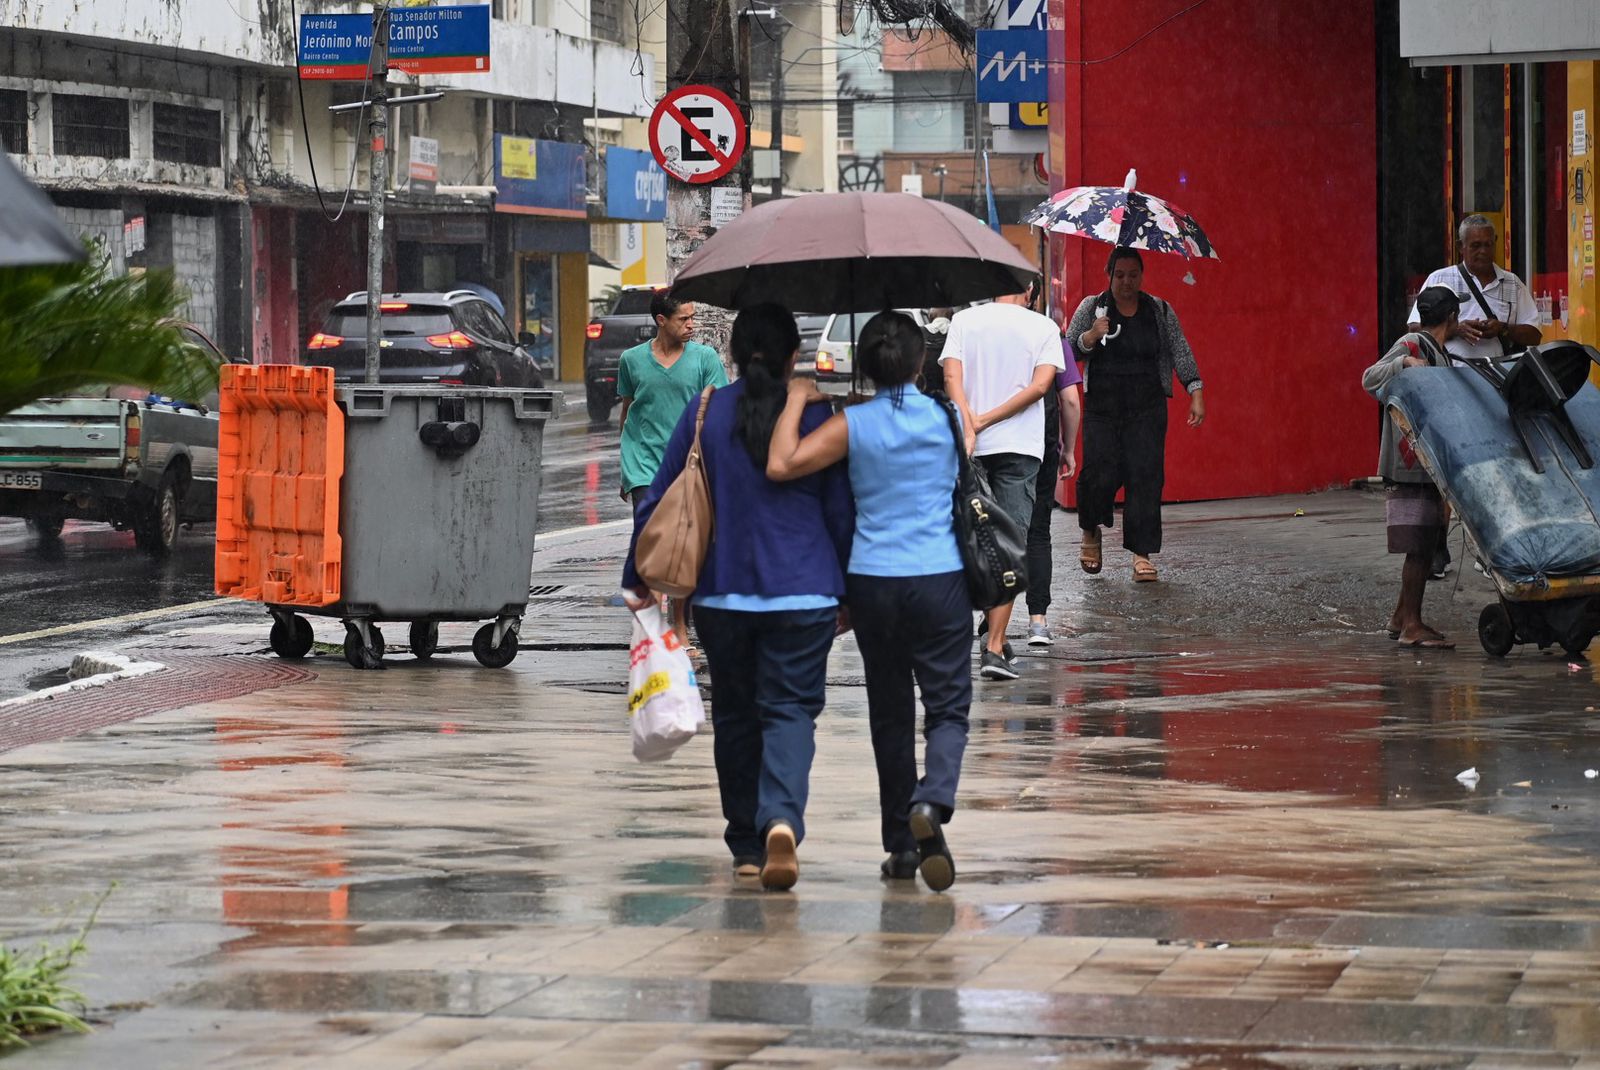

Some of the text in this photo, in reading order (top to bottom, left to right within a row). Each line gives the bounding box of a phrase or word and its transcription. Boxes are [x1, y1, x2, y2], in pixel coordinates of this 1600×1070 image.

[390, 10, 463, 22] Rua Senador Milton
[305, 19, 337, 30] Avenida
[389, 24, 439, 43] Campos
[304, 34, 352, 49] Jerônimo
[389, 45, 425, 54] Bairro Centro
[681, 107, 714, 161] E
